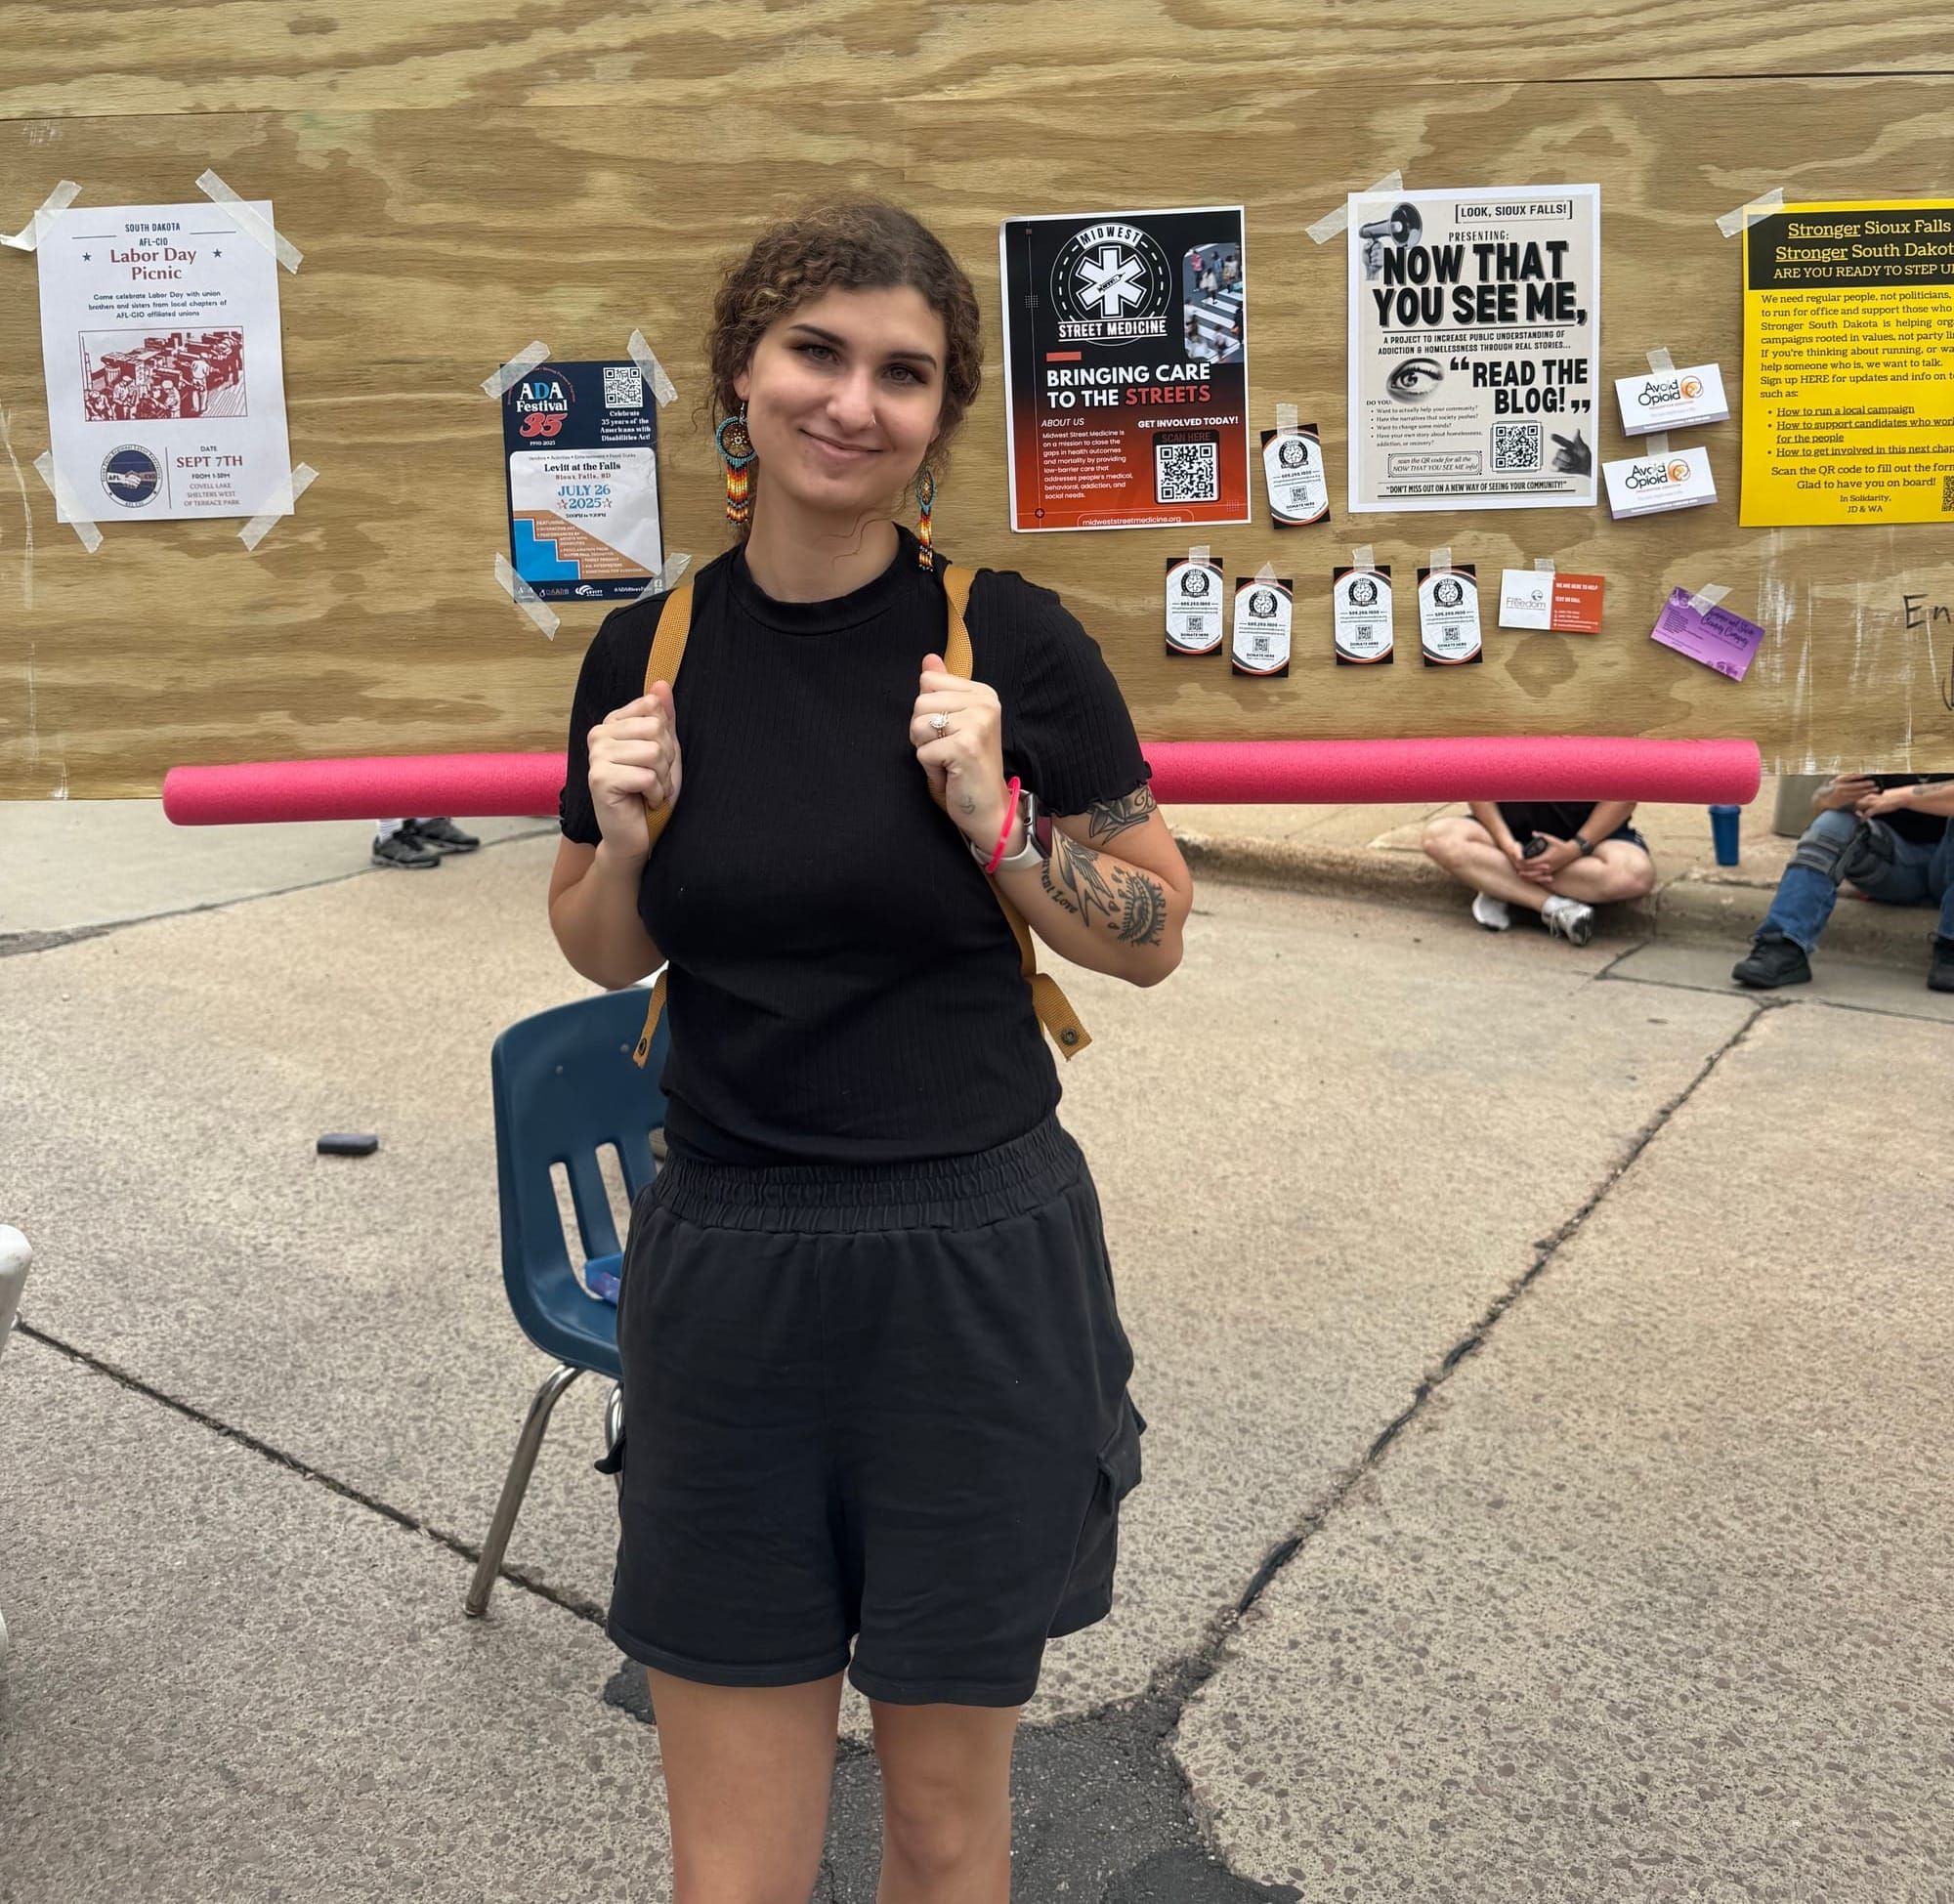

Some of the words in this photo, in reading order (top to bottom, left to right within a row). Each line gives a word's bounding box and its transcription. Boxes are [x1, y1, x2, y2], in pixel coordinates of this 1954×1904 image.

[125, 224, 149, 233] SOUTH
[152, 223, 180, 232] DAKOTA
[1787, 223, 1860, 239] Stronger
[1865, 222, 1910, 234] Sioux
[1915, 220, 1951, 233] Falls
[1080, 227, 1139, 245] MIDWEST
[1449, 232, 1509, 241] PRESENTING:
[110, 248, 159, 264] Labor
[164, 248, 196, 262] Day
[1775, 246, 1848, 263] Stronger
[1851, 244, 1900, 258] South
[1905, 243, 1954, 257] Dakot
[1382, 244, 1466, 285] NOW
[1472, 240, 1570, 282] THAT
[132, 267, 182, 280] Picnic
[1773, 269, 1801, 278] ARE
[1803, 268, 1833, 277] YOU
[1836, 266, 1882, 277] READY
[1884, 266, 1901, 275] TO
[1905, 265, 1937, 275] STEP
[1940, 264, 1954, 275] U
[1762, 295, 1777, 304] We
[1780, 294, 1803, 303] need
[1806, 293, 1840, 304] regular
[1844, 293, 1878, 304] people,
[1881, 292, 1895, 301] not
[1899, 290, 1951, 301] politicians,
[1373, 286, 1444, 327] YOU
[1452, 283, 1517, 324] SEE
[1526, 281, 1588, 325] ME,
[1793, 308, 1807, 317] for
[1810, 307, 1839, 316] office
[1841, 307, 1859, 316] and
[1861, 306, 1899, 316] support
[1902, 305, 1928, 314] those
[1932, 304, 1952, 313] who
[1058, 323, 1102, 338] STREET
[1107, 320, 1167, 336] MEDICINE
[1497, 331, 1553, 340] UNDERSTANDING
[1378, 346, 1415, 355] ADDICTION
[1424, 344, 1477, 354] HOMELESSNESS
[1480, 343, 1512, 352] THROUGH
[1046, 366, 1149, 387] BRINGING
[1156, 363, 1211, 381] CARE
[520, 382, 564, 400] ADA
[1645, 379, 1678, 393] Avod
[1047, 392, 1076, 408] TO
[1082, 390, 1119, 407] THE
[1126, 385, 1211, 405] STREETS
[1638, 390, 1680, 405] Opioid
[516, 401, 568, 412] Festival
[1777, 407, 1800, 417] How
[1803, 406, 1812, 416] to
[1814, 407, 1832, 416] run
[1843, 406, 1865, 415] local
[1868, 405, 1915, 415] campaign
[519, 412, 568, 437] 35
[1041, 418, 1071, 427] ABOUT
[1138, 420, 1155, 429] GET
[1157, 418, 1202, 428] INVOLVED
[1204, 416, 1239, 425] TODAY!
[1162, 433, 1186, 443] SCAN
[1188, 432, 1211, 441] HERE
[177, 456, 211, 468] SEPT
[216, 455, 242, 467] 7TH
[1633, 463, 1665, 476] Avod
[1527, 481, 1566, 489] COMMUNITY!"
[1626, 473, 1668, 488] Opioid
[1797, 480, 1820, 489] Glad
[1824, 480, 1834, 488] to
[1837, 479, 1862, 488] have
[1864, 481, 1885, 489] you
[1902, 478, 1936, 487] board!
[558, 485, 590, 496] JULY
[594, 485, 611, 495] 26
[569, 498, 602, 509] 2025
